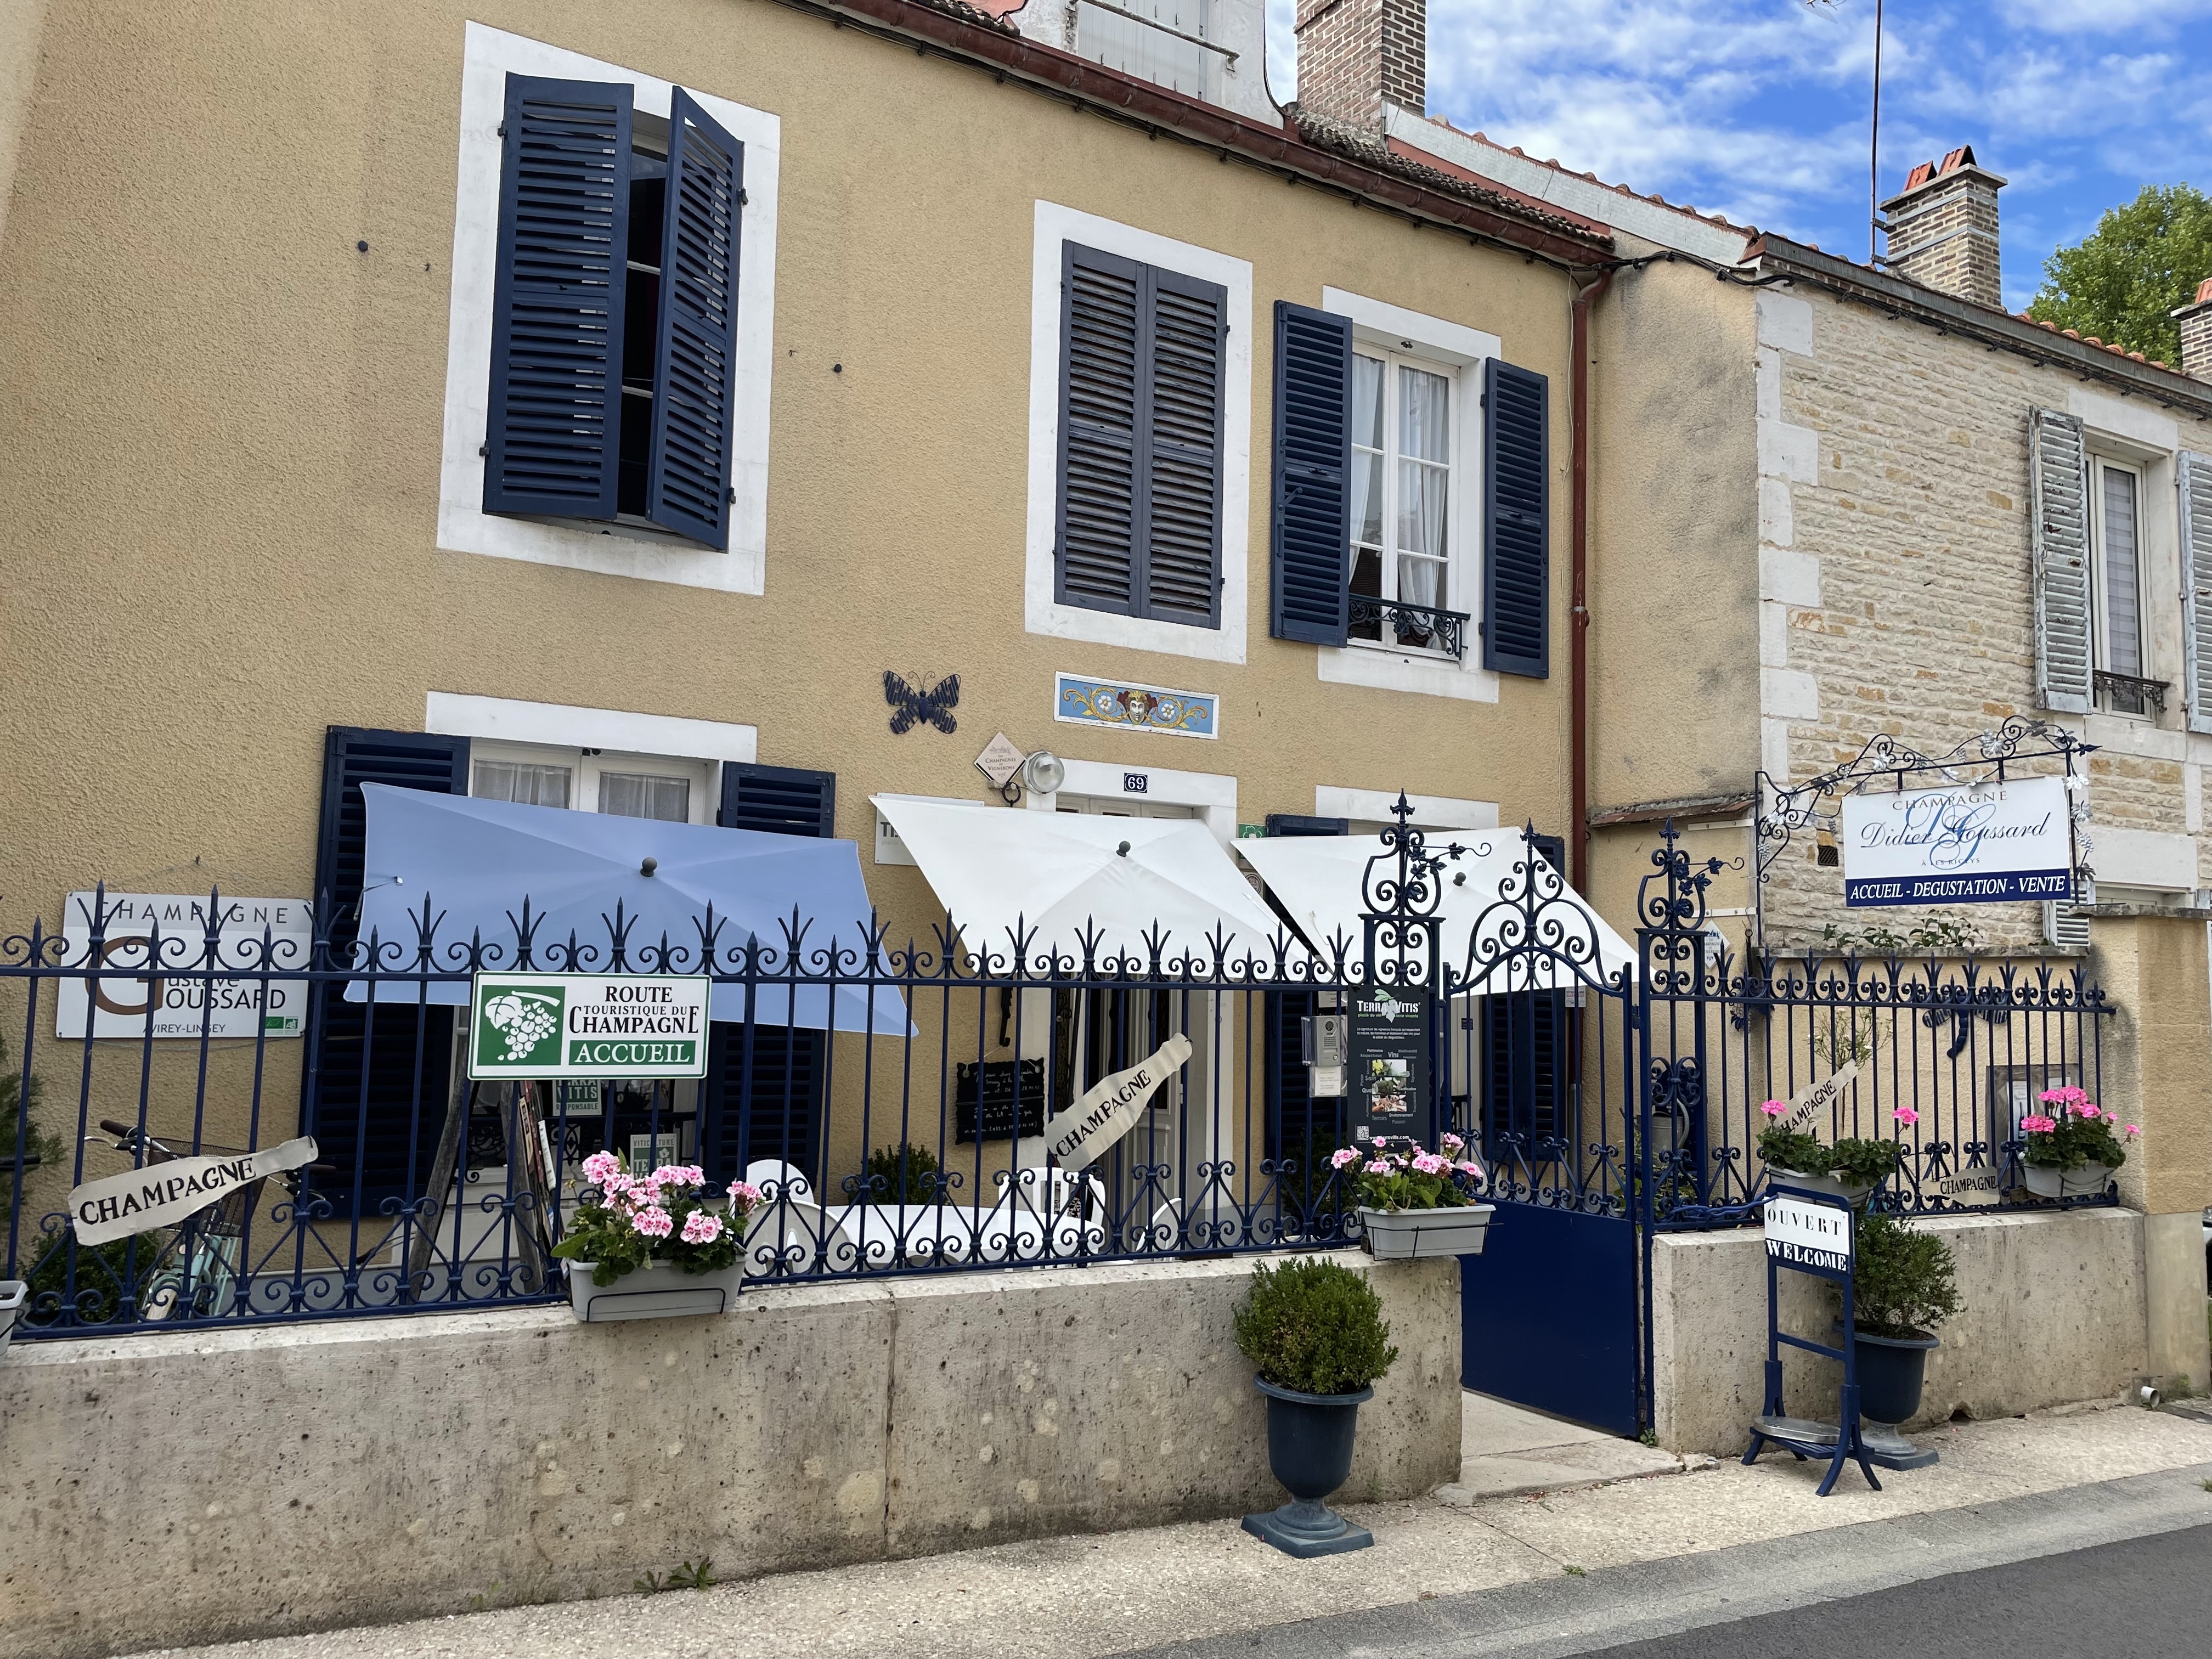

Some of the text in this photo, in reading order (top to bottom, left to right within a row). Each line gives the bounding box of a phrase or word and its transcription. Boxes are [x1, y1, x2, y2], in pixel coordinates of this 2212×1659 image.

[1127, 777, 1144, 790] 69
[1893, 791, 2007, 810] CHAMPAGNE
[1861, 812, 2052, 848] Didier Goussard
[1850, 883, 1904, 900] ACCUEIL
[1913, 878, 2009, 898] DEGUSTATION
[2019, 876, 2066, 893] VENTE
[605, 986, 673, 1003] ROUTE
[569, 1006, 699, 1034] CHAMPAGNE
[584, 1005, 687, 1015] TOURISTIQUE DU
[574, 1043, 690, 1063] ACCUEIL
[1056, 1070, 1152, 1156] CHAMPAGNE
[1780, 1080, 1837, 1132] HAMPAGNE
[634, 1158, 672, 1172] TERA
[80, 1158, 256, 1226] CHAMPAGNE
[1940, 1175, 1999, 1195] CHAMPAGNE
[1768, 1207, 1842, 1236] OUVERT
[1766, 1239, 1847, 1272] WELCOME
